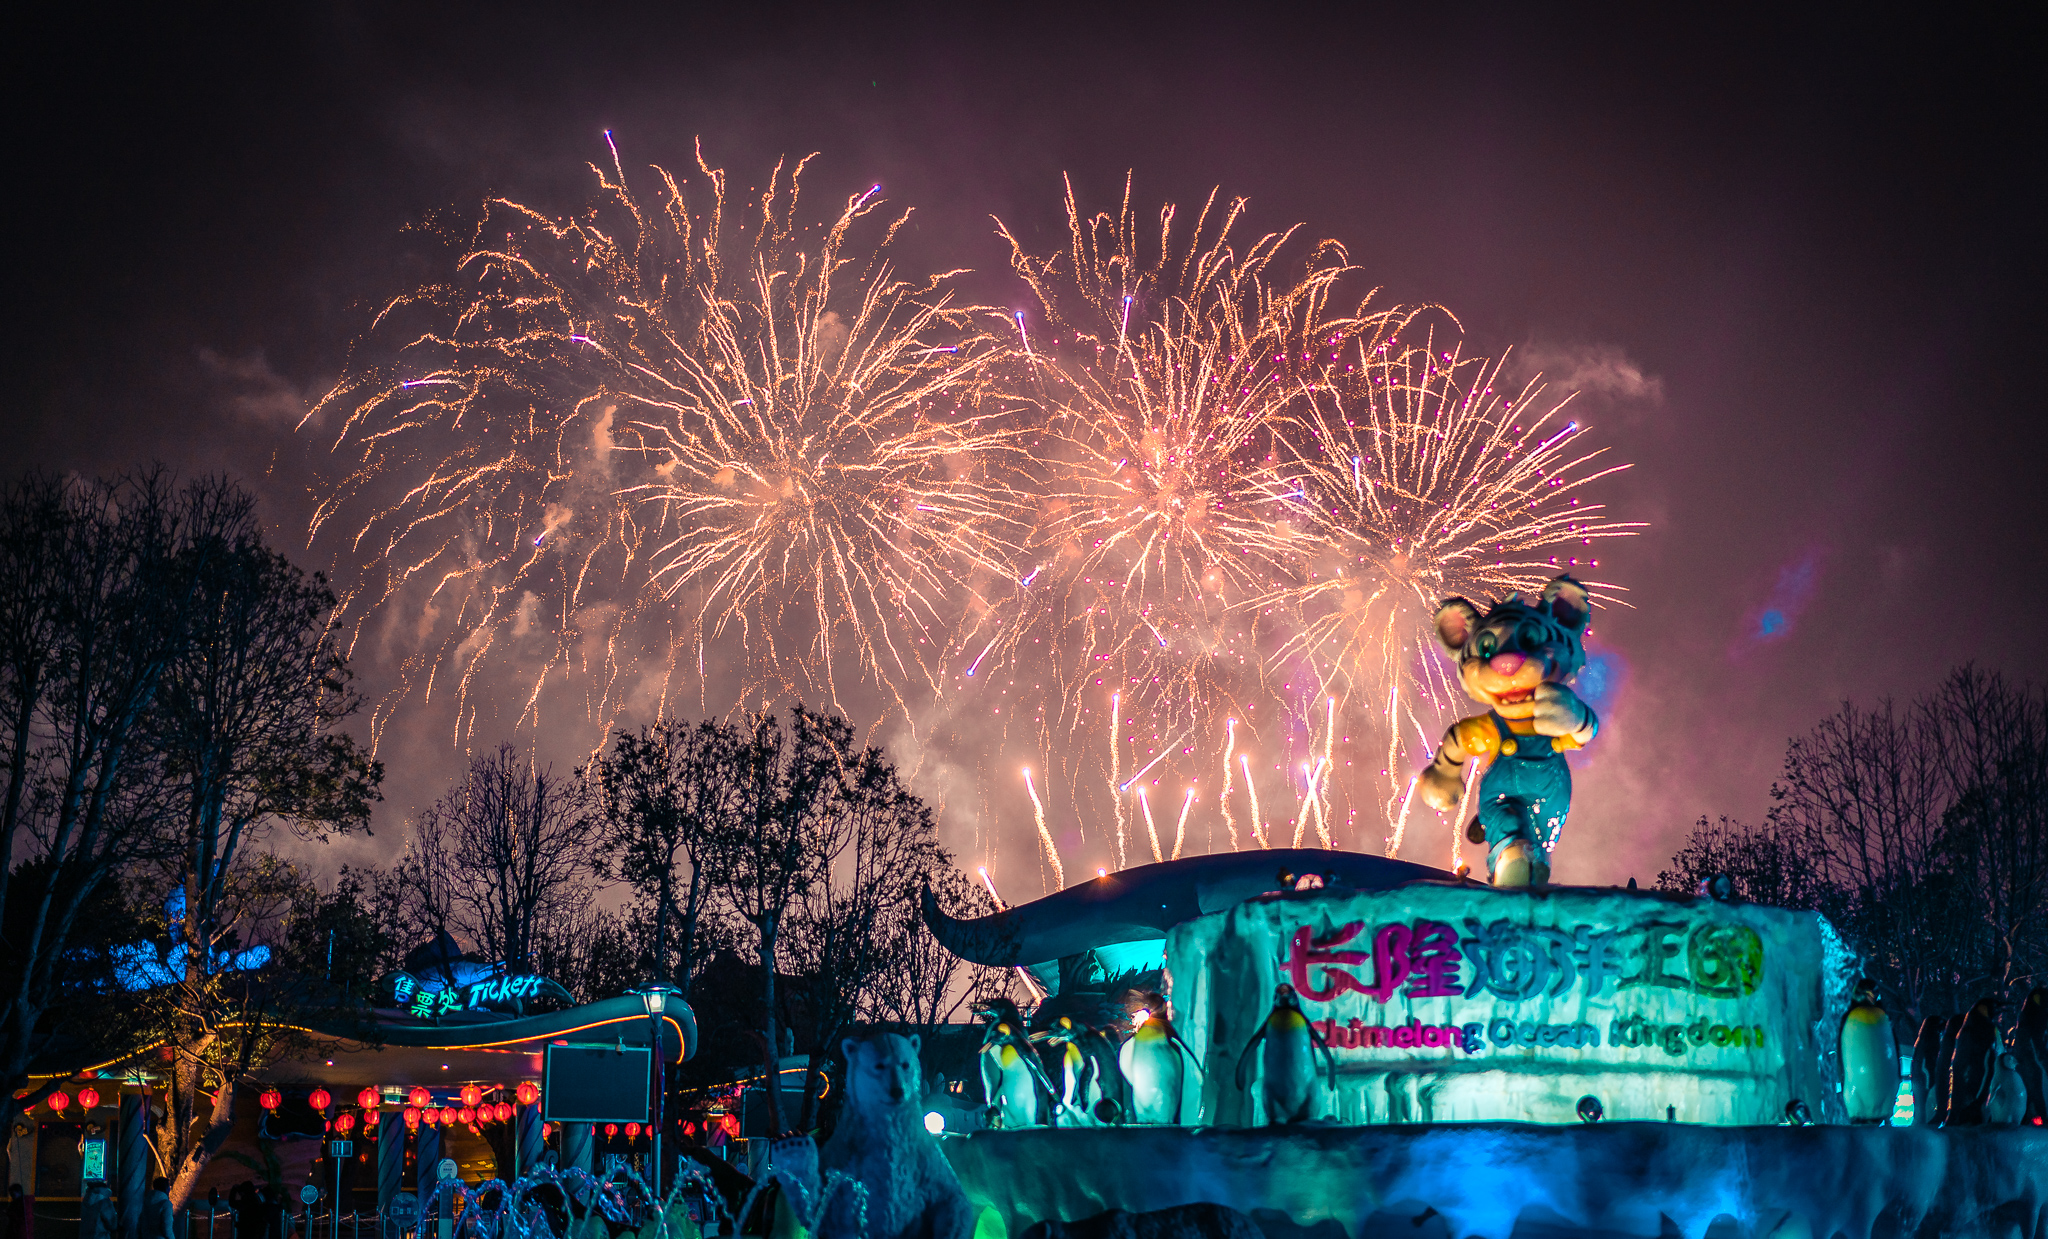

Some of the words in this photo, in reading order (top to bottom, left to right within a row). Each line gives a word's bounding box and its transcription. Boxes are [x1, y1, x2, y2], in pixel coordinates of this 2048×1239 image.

[394, 974, 464, 1019] 售票处
[1487, 1017, 1600, 1049] Ocean
[1608, 1013, 1764, 1057] Kingdom
